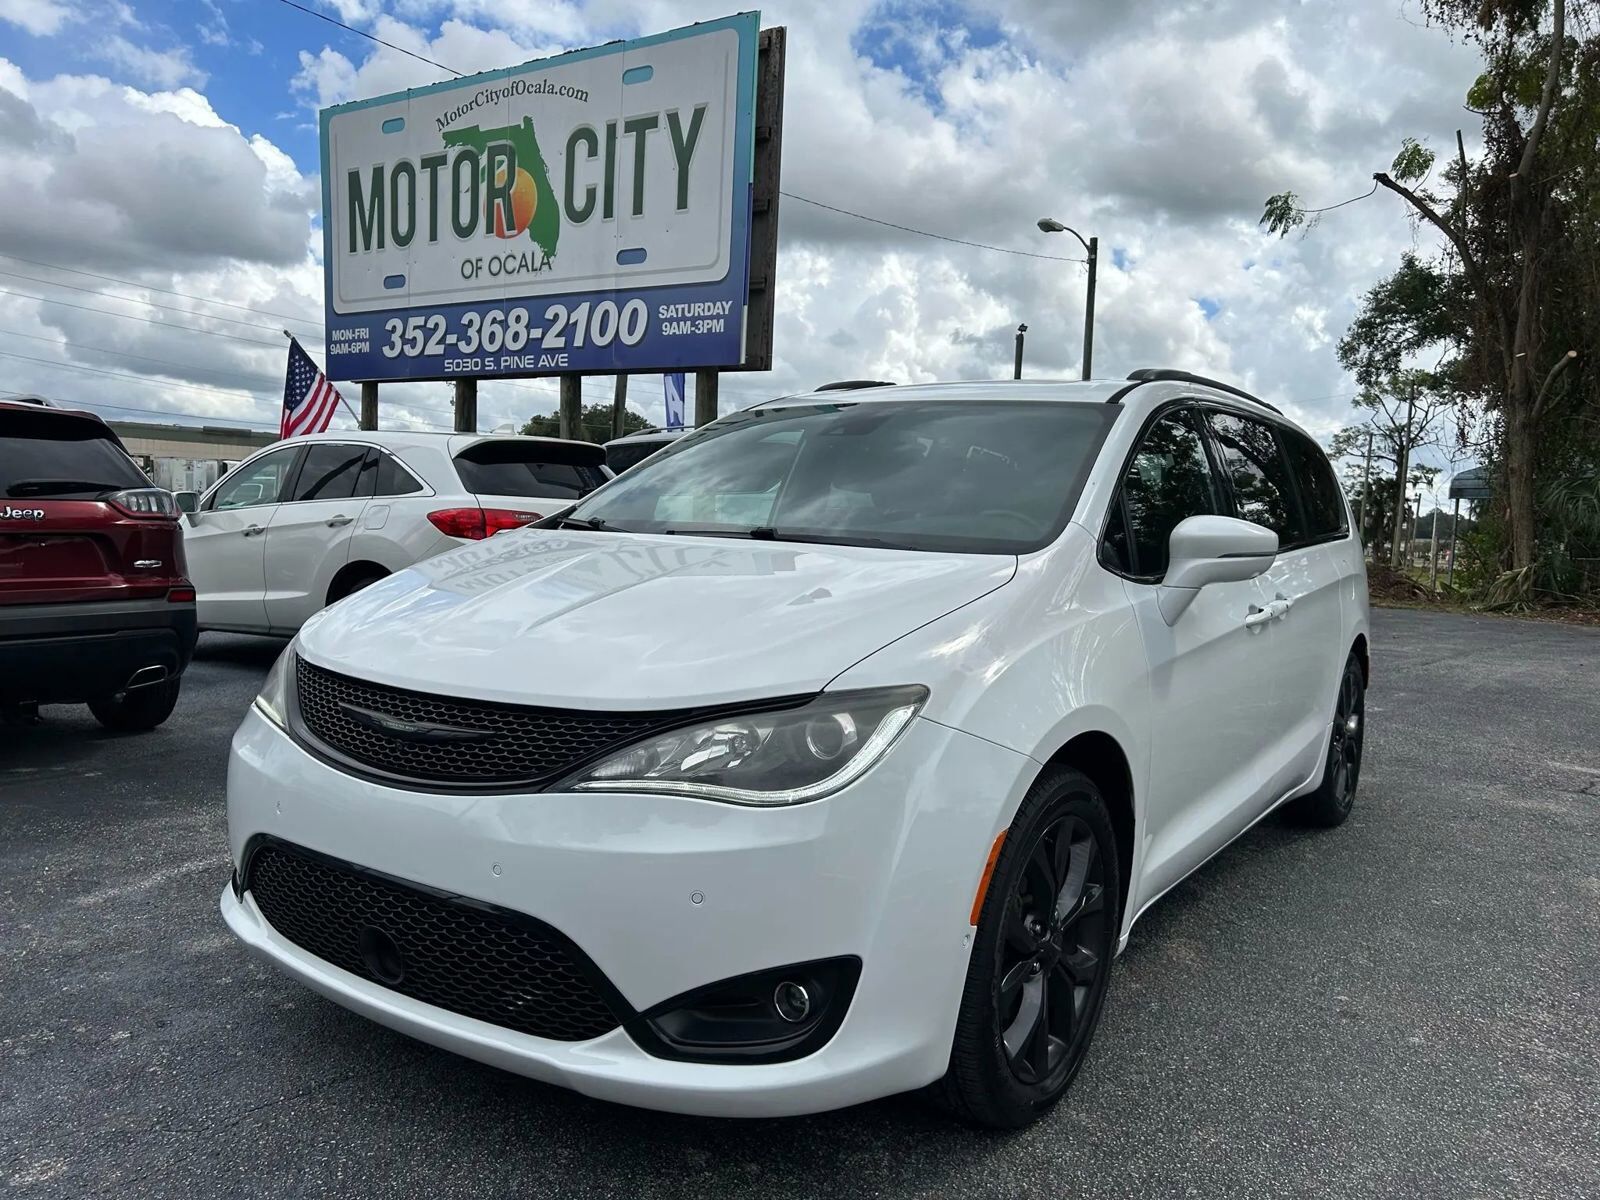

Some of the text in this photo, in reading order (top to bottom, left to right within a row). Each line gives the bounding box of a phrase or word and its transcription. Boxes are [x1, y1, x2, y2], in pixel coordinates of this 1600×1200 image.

[435, 79, 589, 132] MotorCityofOcala.com
[347, 103, 709, 254] MOTOR CITY
[460, 251, 553, 279] OF OCALA
[658, 301, 733, 319] SATURDAY
[332, 327, 370, 341] MON-FRI
[382, 298, 648, 358] 352-368-2100
[662, 319, 724, 335] 9AM-3PM
[330, 341, 370, 355] 9AM-6PM
[444, 353, 568, 372] 5030 S. PINE AVE
[0, 506, 45, 521] Jeep
